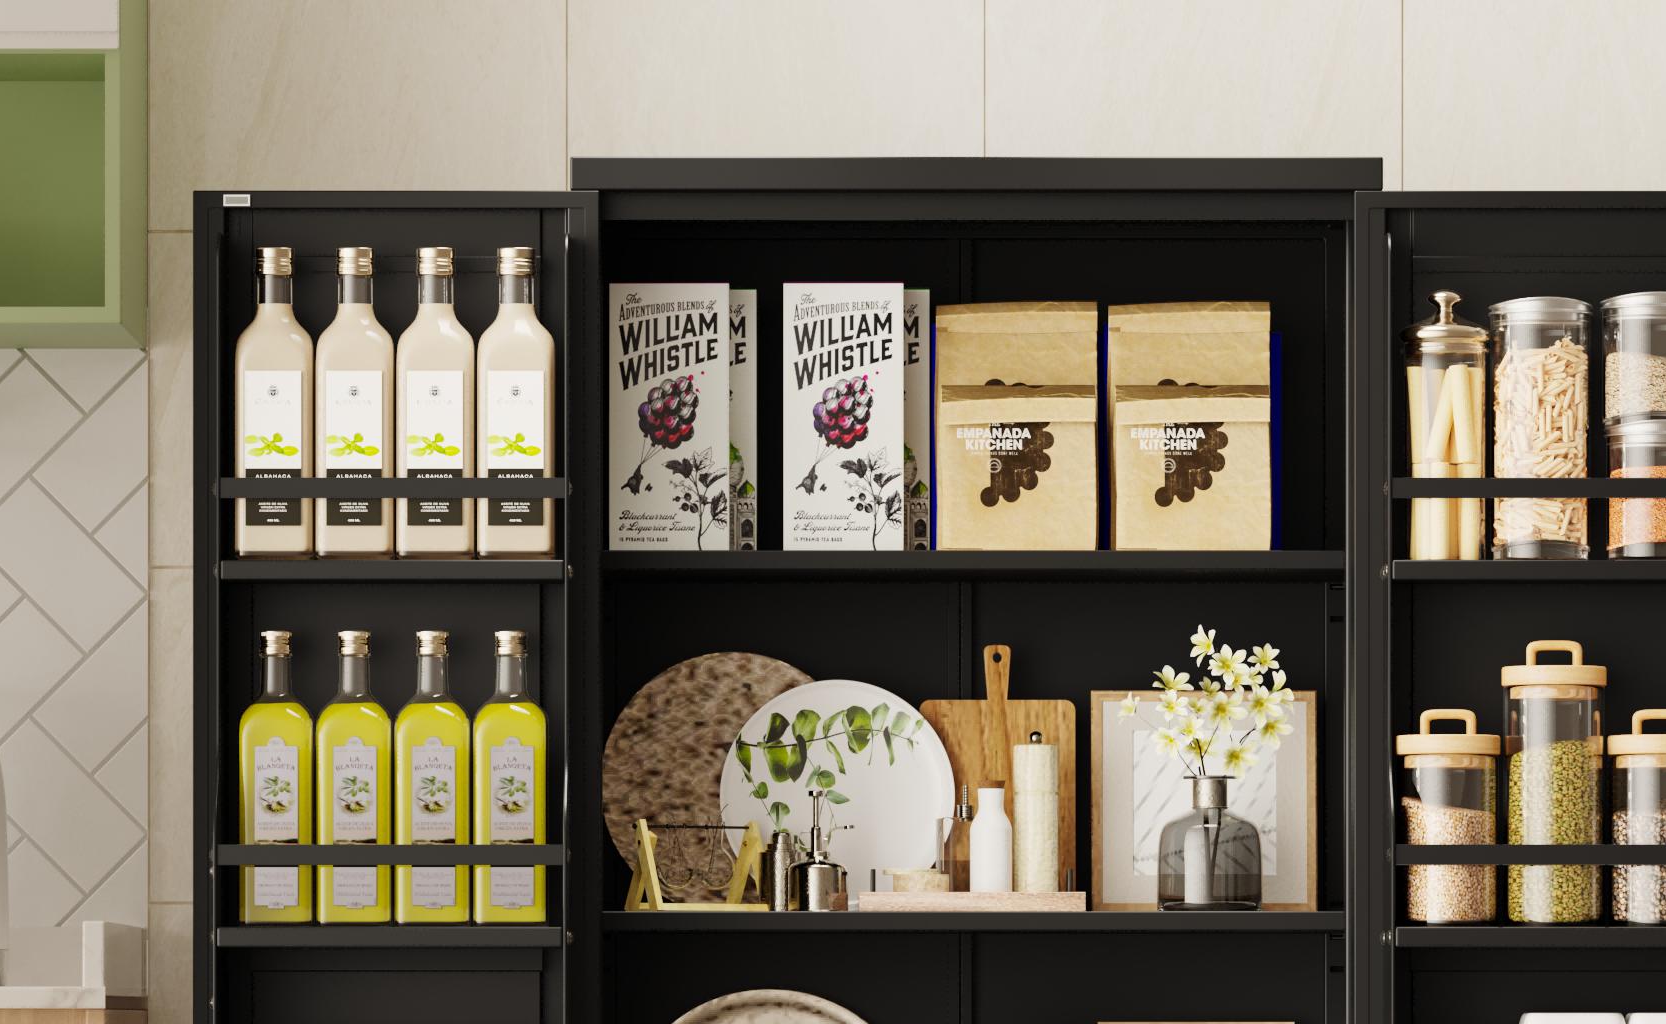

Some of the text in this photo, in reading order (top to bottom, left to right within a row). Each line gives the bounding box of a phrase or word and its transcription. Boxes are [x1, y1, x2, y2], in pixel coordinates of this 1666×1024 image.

[625, 293, 641, 305] The
[801, 293, 816, 305] The
[677, 301, 704, 311] BLENDS
[852, 301, 879, 311] BLENDS
[619, 312, 718, 356] WILLIAM
[793, 312, 892, 356] WILLIAM
[619, 338, 718, 391] WHISTLE
[794, 338, 893, 391] WHISTLE
[957, 428, 1031, 439] EMPANADA
[1130, 428, 1205, 439] EMPANADA
[965, 439, 1023, 450] KITCHEN
[1139, 439, 1197, 450] KITCHEN
[619, 510, 677, 521] Blackcurrant
[793, 510, 851, 521] Blackcurrant
[627, 522, 666, 535] Liquorice
[669, 522, 695, 532] Tisane
[801, 522, 841, 535] Liquorice
[844, 522, 870, 532] Tisane
